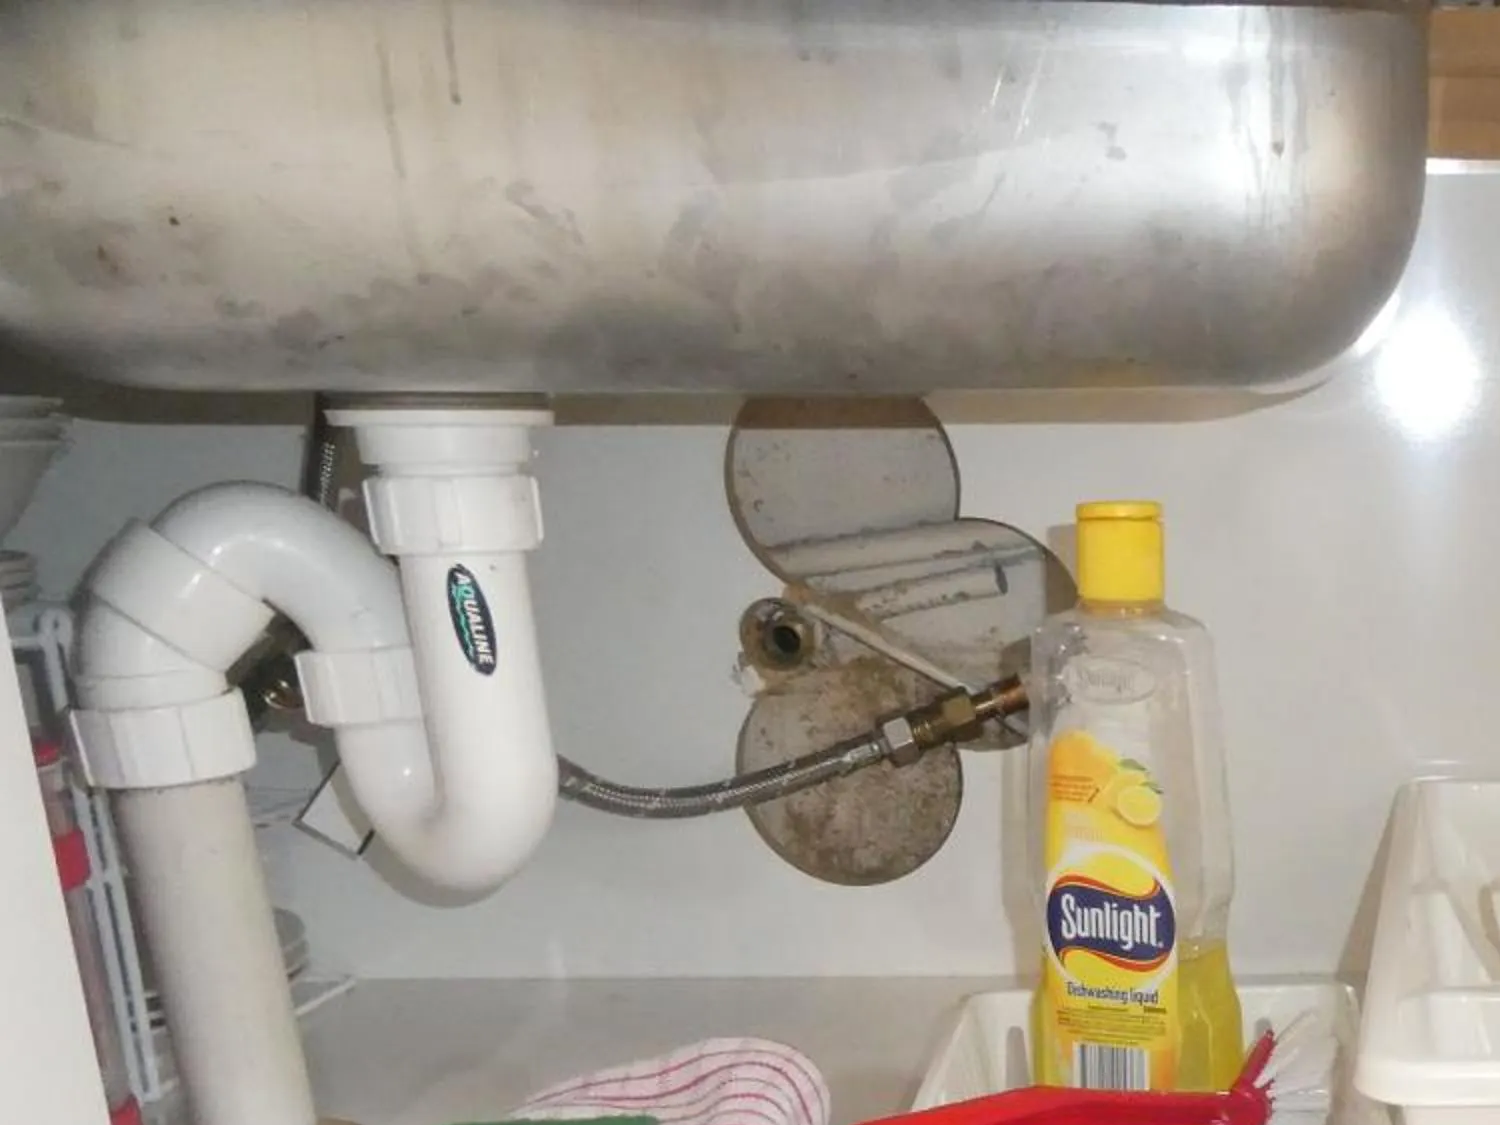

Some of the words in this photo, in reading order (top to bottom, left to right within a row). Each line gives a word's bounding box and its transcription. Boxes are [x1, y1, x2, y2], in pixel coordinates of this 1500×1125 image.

[453, 571, 494, 665] AQUALINE
[1060, 893, 1161, 949] Sunlight
[1129, 987, 1159, 1006] liquid
